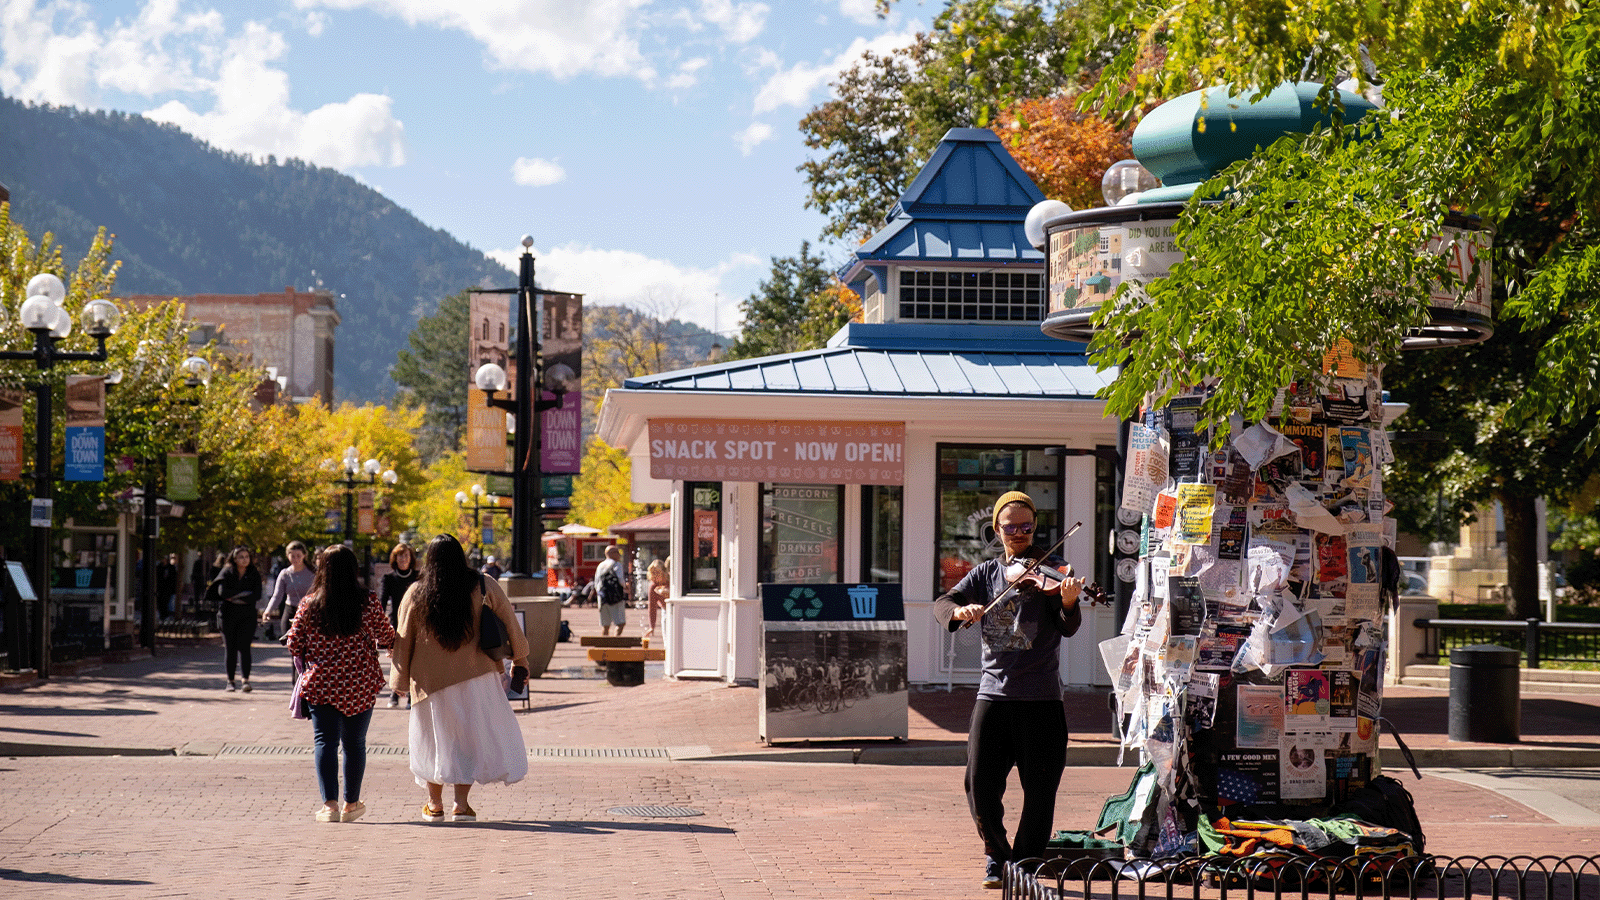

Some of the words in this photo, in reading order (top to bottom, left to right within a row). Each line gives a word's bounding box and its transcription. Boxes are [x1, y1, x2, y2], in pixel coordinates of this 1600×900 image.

[1129, 227, 1142, 239] DID
[1145, 226, 1161, 238] YOU
[1163, 226, 1177, 238] KN
[1149, 241, 1165, 253] ARE
[547, 410, 577, 429] DOWN
[1271, 425, 1323, 438] MAMMOTHS
[71, 437, 99, 450] DOWN
[547, 430, 577, 450] TOWN
[73, 450, 98, 463] TOWN
[651, 439, 718, 459] SNACK
[724, 440, 776, 459] SPOT
[795, 442, 838, 461] NOW
[845, 442, 902, 462] OPEN!
[774, 488, 829, 499] POPCORN
[967, 506, 995, 525] SNAC
[770, 510, 833, 536] PRETZELS
[780, 543, 821, 554] DRINKS
[788, 567, 822, 578] MORE
